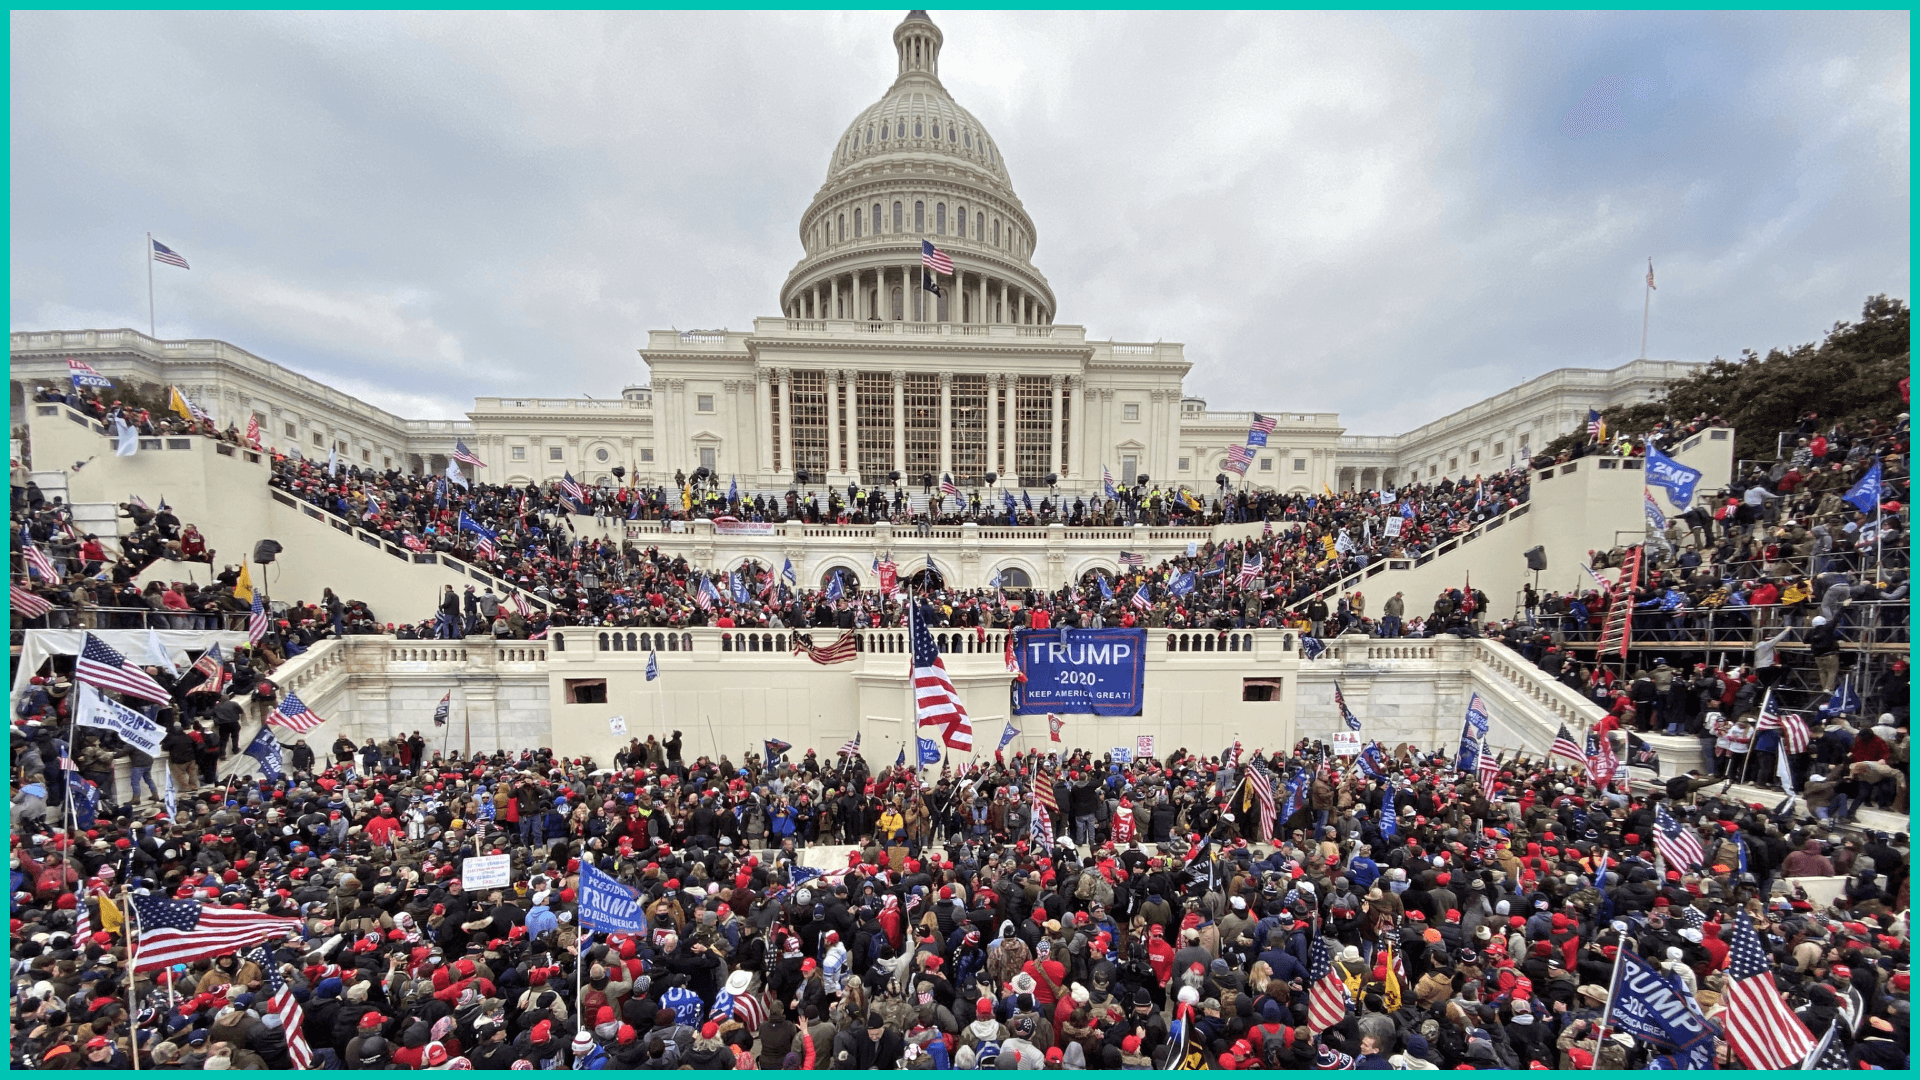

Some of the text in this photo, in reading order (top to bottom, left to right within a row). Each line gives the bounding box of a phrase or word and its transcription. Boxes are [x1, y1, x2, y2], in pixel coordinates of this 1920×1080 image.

[80, 376, 112, 387] 2020
[1028, 642, 1131, 665] TRUMP
[1028, 689, 1131, 699] KEEP AMERICA GREAT!
[116, 711, 141, 730] 2020
[93, 715, 105, 725] NO
[120, 728, 156, 750] BULLSHIT
[582, 886, 638, 918] TRUMP
[1623, 956, 1704, 1033] RUMP
